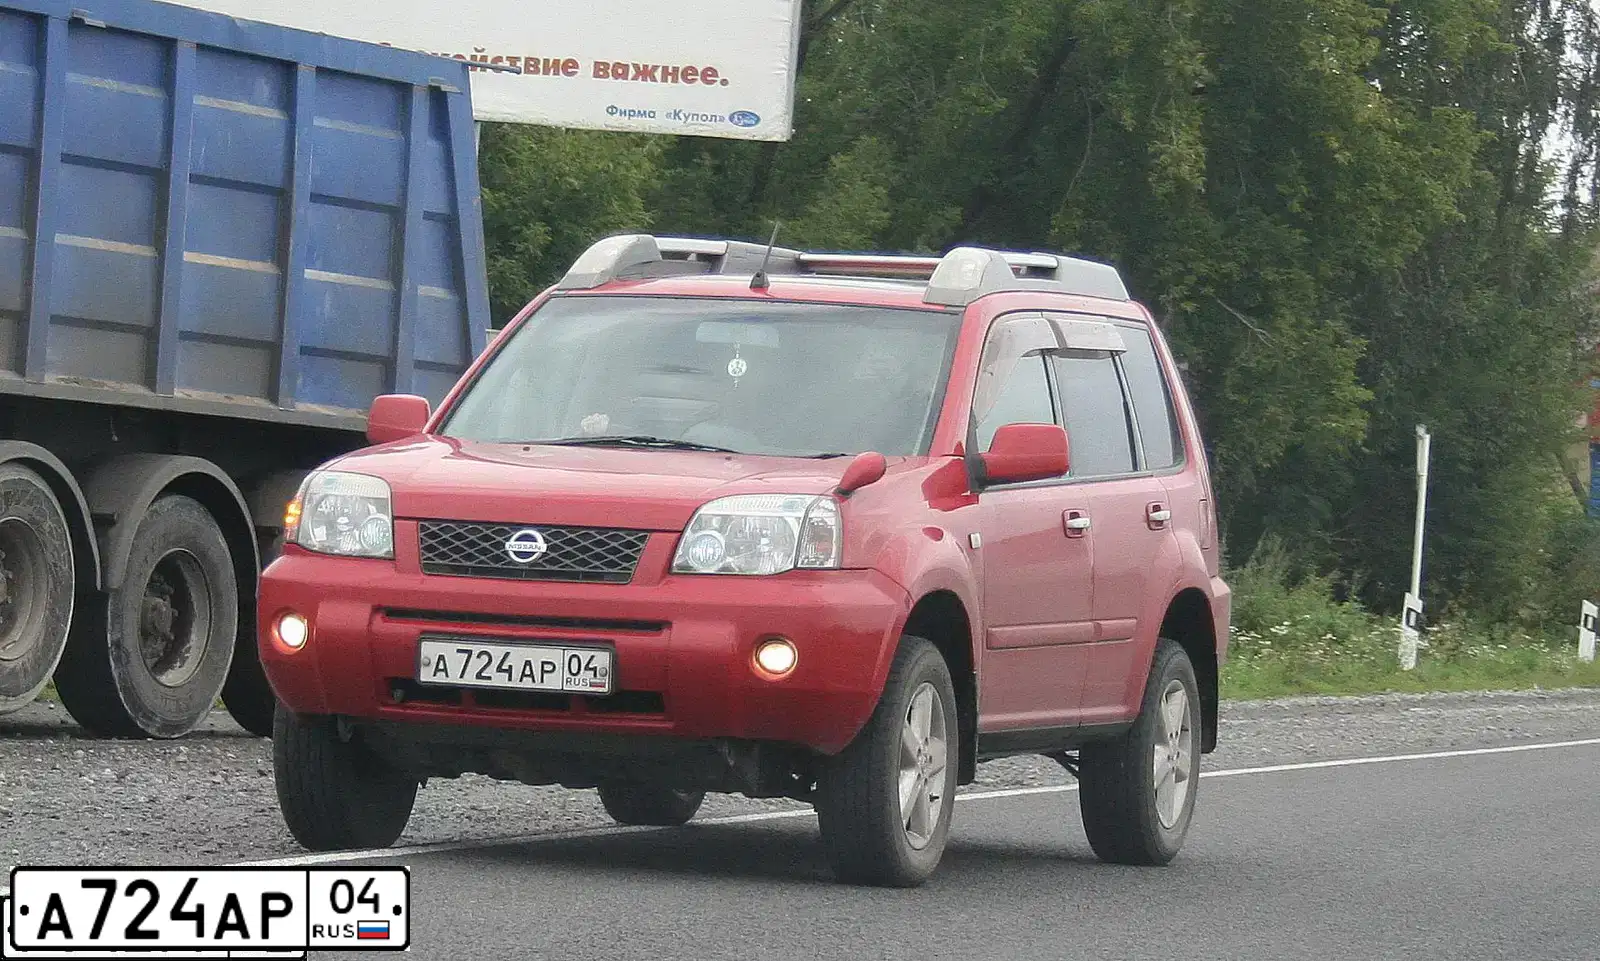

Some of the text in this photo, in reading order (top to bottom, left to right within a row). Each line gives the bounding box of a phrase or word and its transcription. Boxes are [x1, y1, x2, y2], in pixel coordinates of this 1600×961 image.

[592, 61, 729, 87] важнее.
[605, 105, 656, 120] Фирма
[665, 109, 726, 124] «Купол»
[508, 543, 542, 551] NISSAN
[567, 653, 599, 678] 04
[565, 677, 589, 687] RUS
